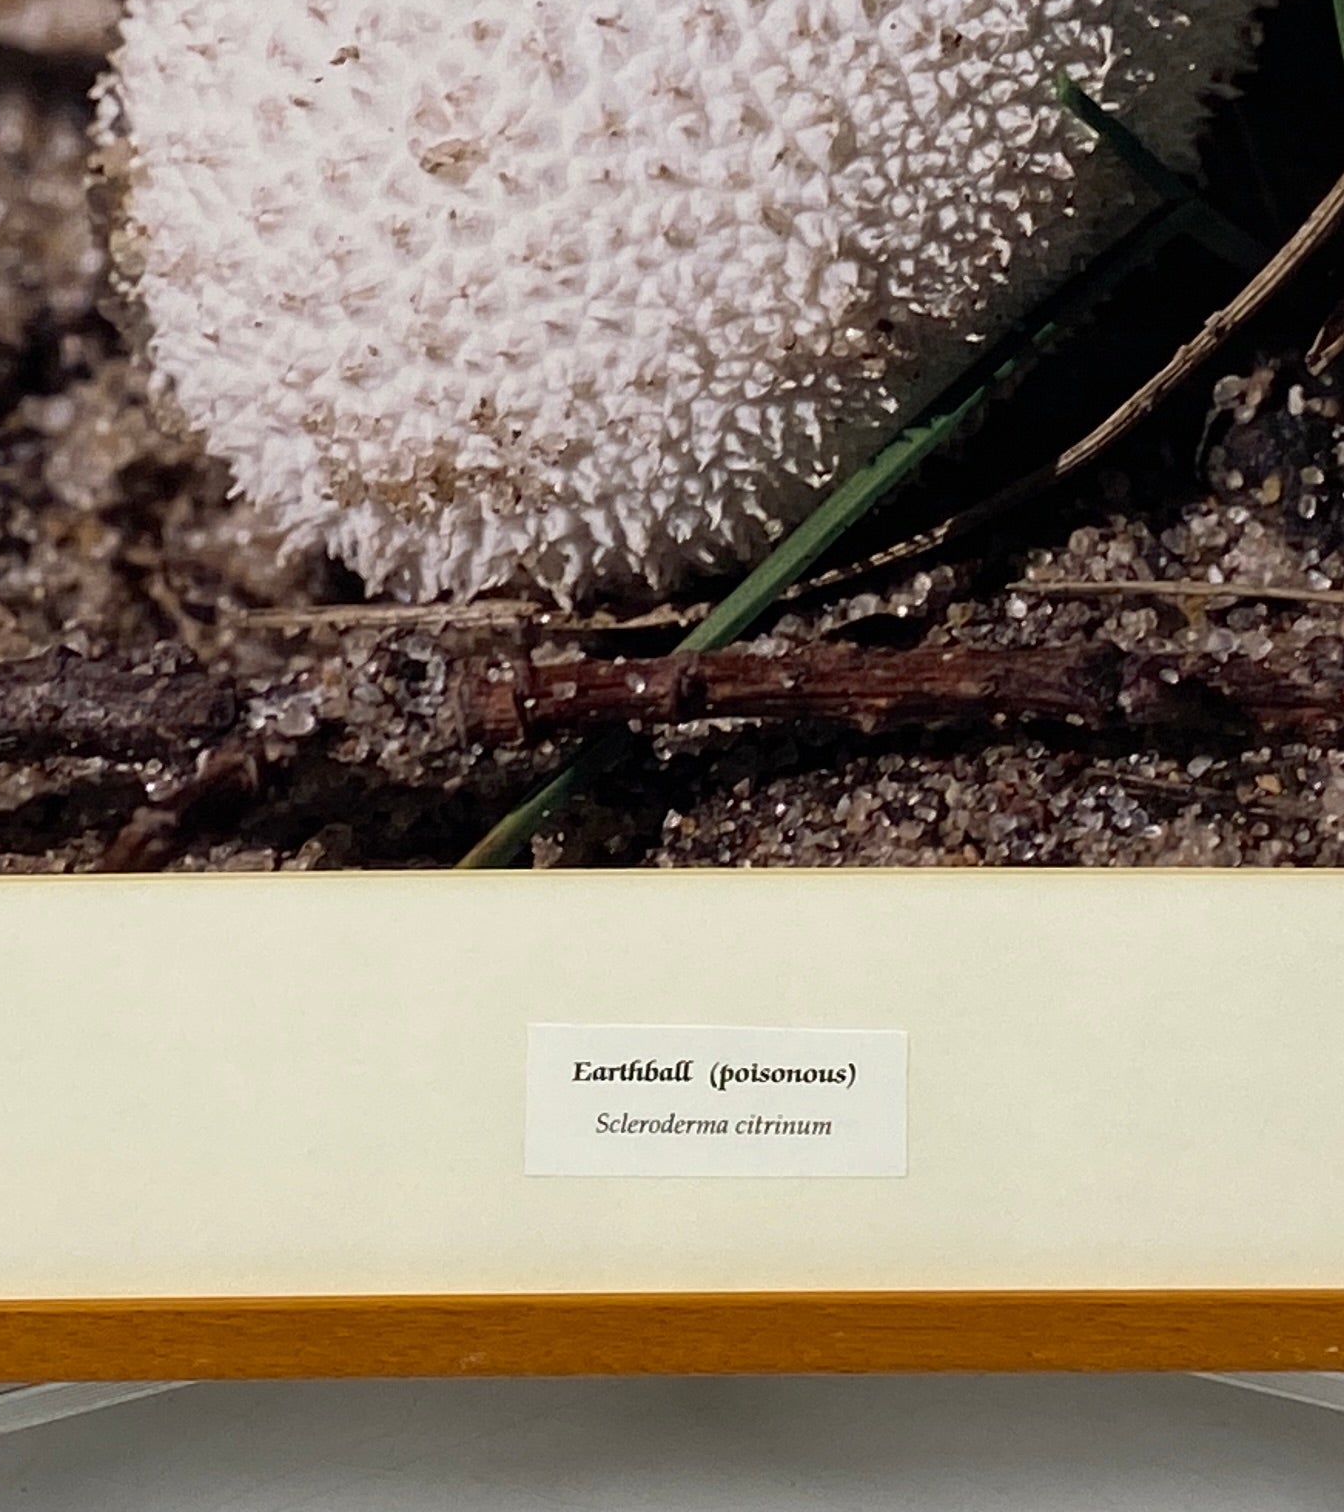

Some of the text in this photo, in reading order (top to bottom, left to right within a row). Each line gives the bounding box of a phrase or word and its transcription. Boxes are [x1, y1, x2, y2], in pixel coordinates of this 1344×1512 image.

[572, 1059, 857, 1091] Earthball (poisonous)
[596, 1112, 832, 1135] Scleroderma citrinum
